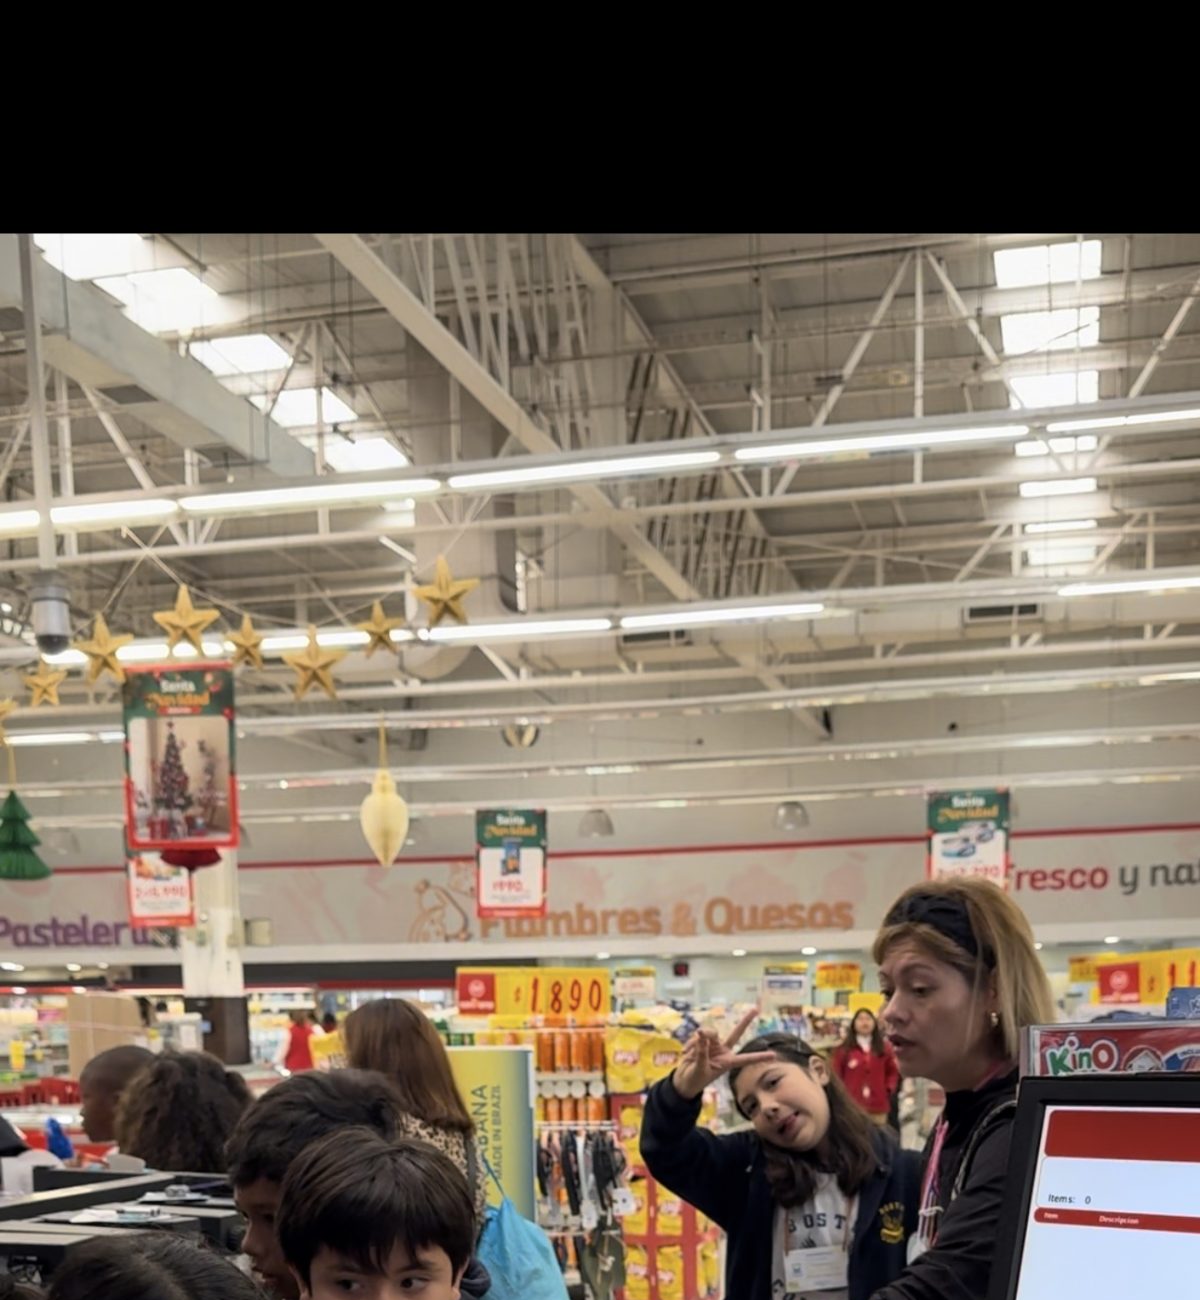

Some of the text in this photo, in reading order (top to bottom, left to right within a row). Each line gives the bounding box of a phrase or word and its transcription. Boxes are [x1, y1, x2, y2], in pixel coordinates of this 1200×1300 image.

[1008, 863, 1109, 892] resco
[1118, 865, 1139, 896] y
[1150, 857, 1200, 887] na
[671, 901, 698, 937] &
[704, 895, 855, 936] Quesos
[1047, 1193, 1092, 1205] Items: 0
